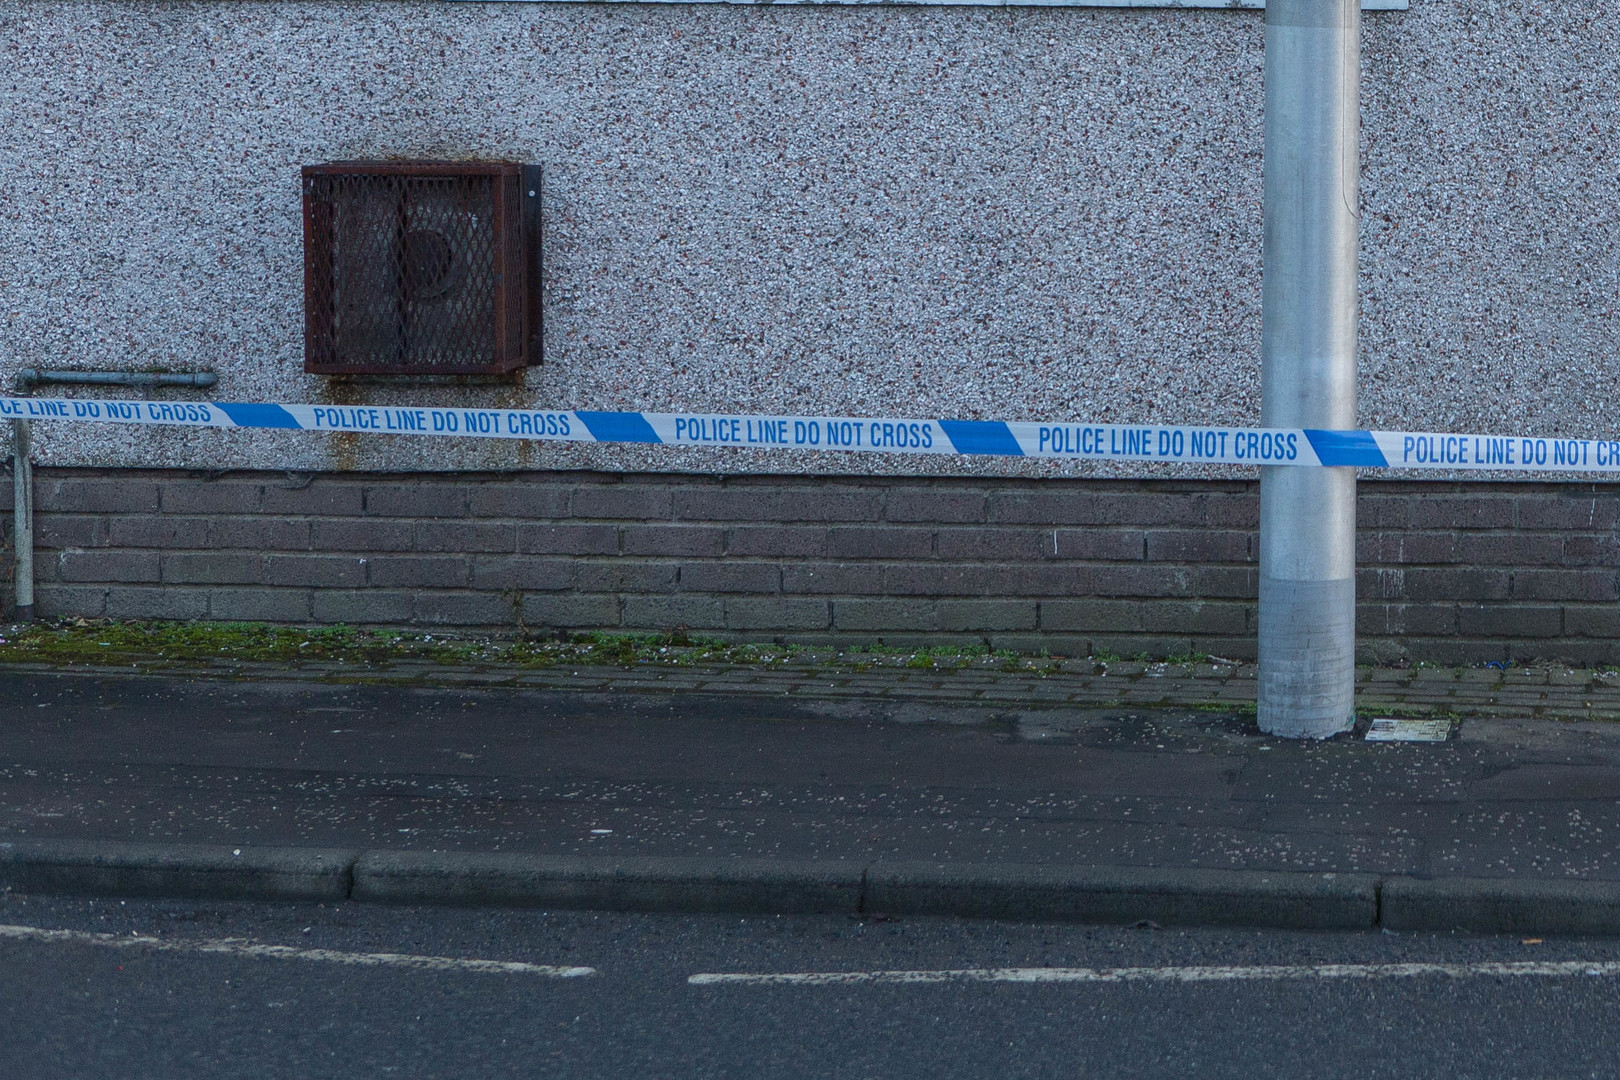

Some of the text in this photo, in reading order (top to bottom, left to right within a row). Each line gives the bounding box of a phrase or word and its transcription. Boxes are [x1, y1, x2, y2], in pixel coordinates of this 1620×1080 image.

[26, 400, 70, 416] LINE
[72, 401, 100, 418] DO
[104, 402, 142, 419] NOT
[148, 403, 211, 423] CROSS
[313, 408, 572, 437] POLICE LINE DO NOT CROSS
[675, 417, 933, 449] POLICE LINE DO NOT CROSS
[1039, 426, 1298, 461] POLICE LINE DO NOT CROSS
[1403, 436, 1469, 464] POLICE
[1474, 437, 1516, 465] LINE
[1521, 439, 1548, 466] DO
[1553, 440, 1590, 466] NOT
